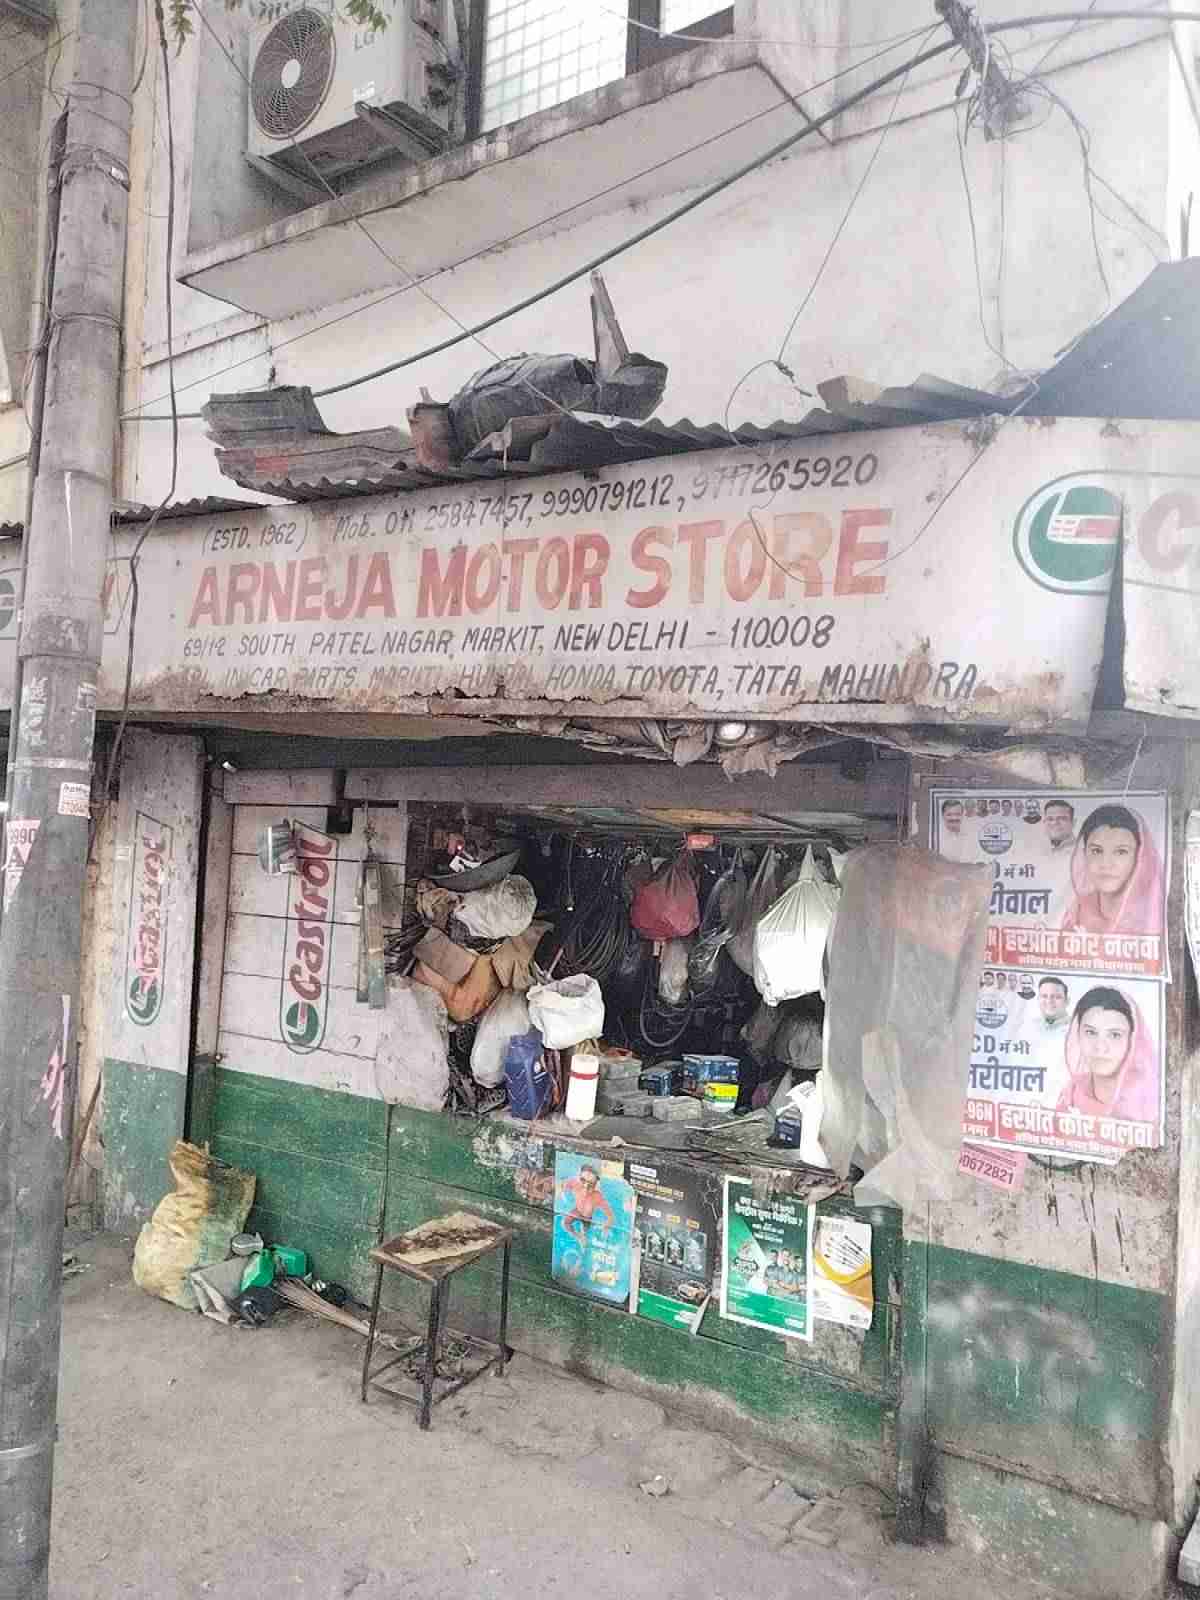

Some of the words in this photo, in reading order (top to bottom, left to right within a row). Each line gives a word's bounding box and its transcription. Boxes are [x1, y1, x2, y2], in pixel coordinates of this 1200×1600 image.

[188, 551, 397, 629] ARNEJA
[416, 531, 611, 618] MOTOR
[626, 508, 892, 609] STORE
[238, 633, 297, 657] SOUTH
[309, 631, 377, 655] PATEL
[553, 623, 605, 651] NEW
[607, 619, 689, 651] DELHI
[730, 614, 836, 649] 110008
[290, 838, 333, 1001] Castrol
